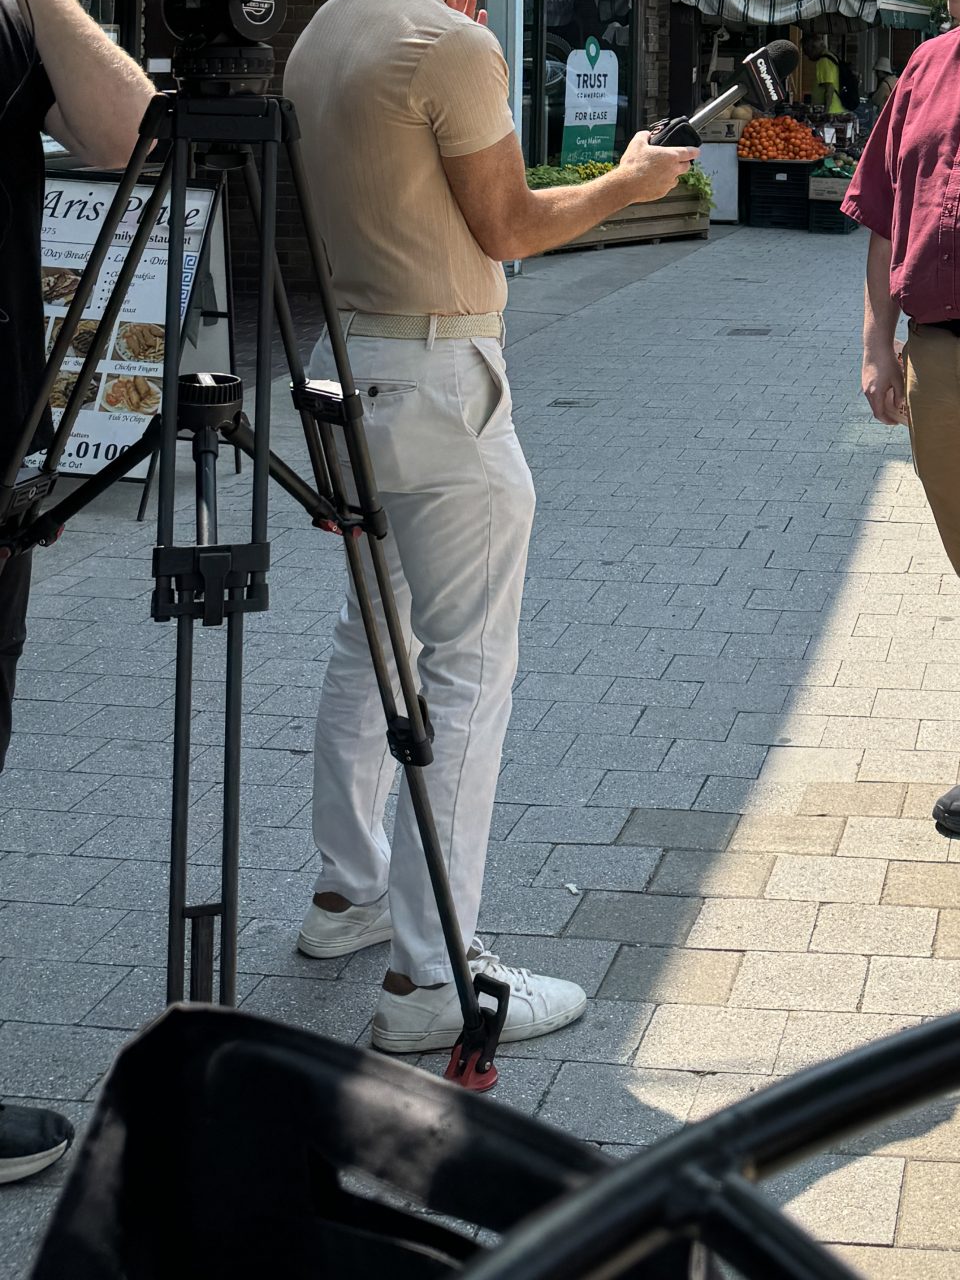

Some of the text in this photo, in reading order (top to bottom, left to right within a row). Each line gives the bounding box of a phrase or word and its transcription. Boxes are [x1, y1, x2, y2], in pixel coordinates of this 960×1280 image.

[576, 73, 608, 89] TRUST
[756, 58, 779, 101] CityNews
[574, 111, 608, 121] FOR LEASE
[41, 190, 105, 221] Aris
[40, 226, 57, 235] 975
[43, 248, 62, 261] Day
[63, 250, 92, 263] Break
[68, 460, 83, 469] Out
